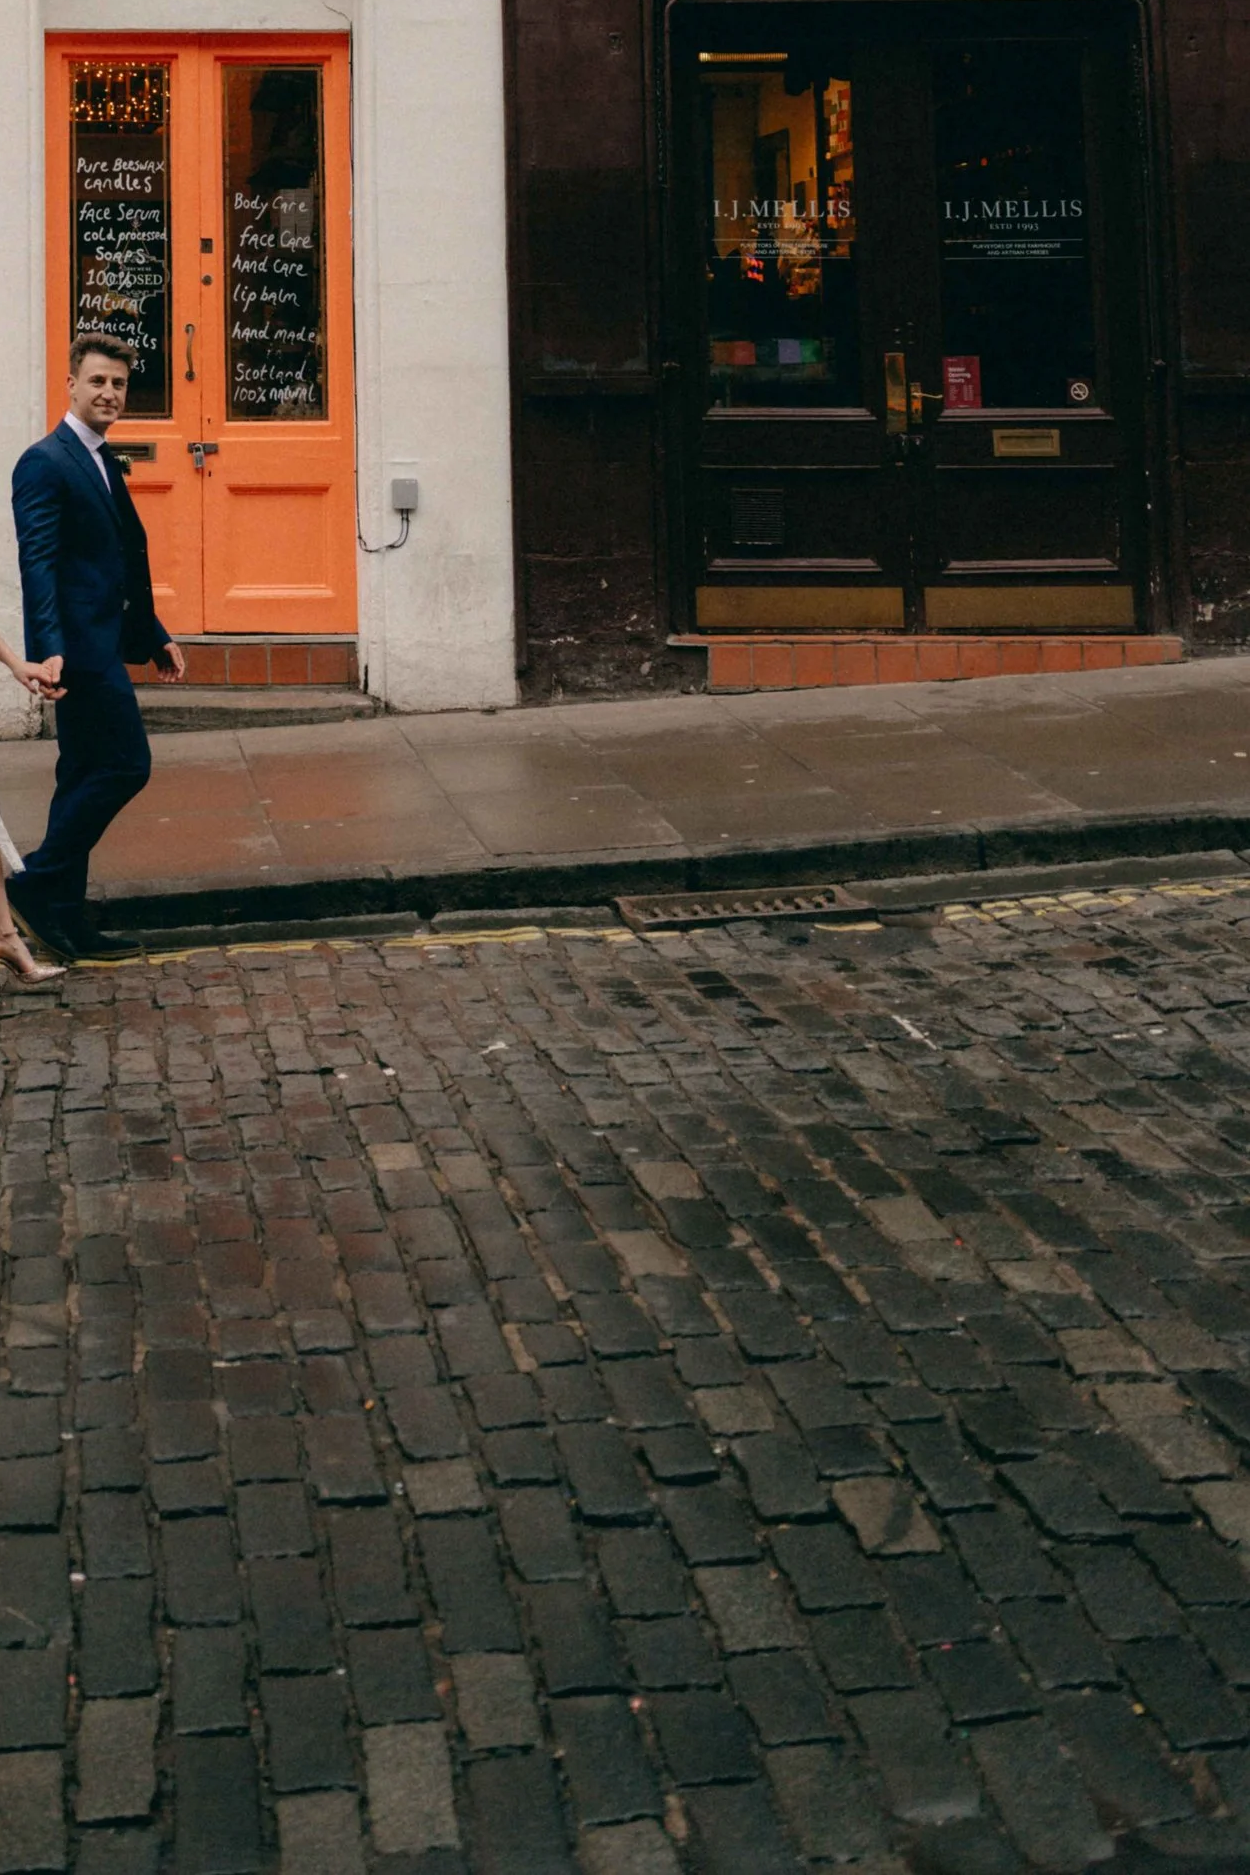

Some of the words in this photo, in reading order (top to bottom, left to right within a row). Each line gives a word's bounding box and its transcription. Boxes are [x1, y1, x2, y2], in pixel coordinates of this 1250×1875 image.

[77, 157, 109, 173] Pure
[234, 192, 269, 220] Body
[272, 196, 308, 214] Care
[83, 226, 116, 242] cold
[115, 226, 168, 250] processed
[1017, 223, 1039, 231] 1993
[280, 230, 314, 253] Care
[273, 259, 308, 277] Care
[85, 269, 132, 291] 100%
[233, 283, 257, 313] lip
[260, 286, 301, 307] balm
[234, 386, 266, 404] 100%
